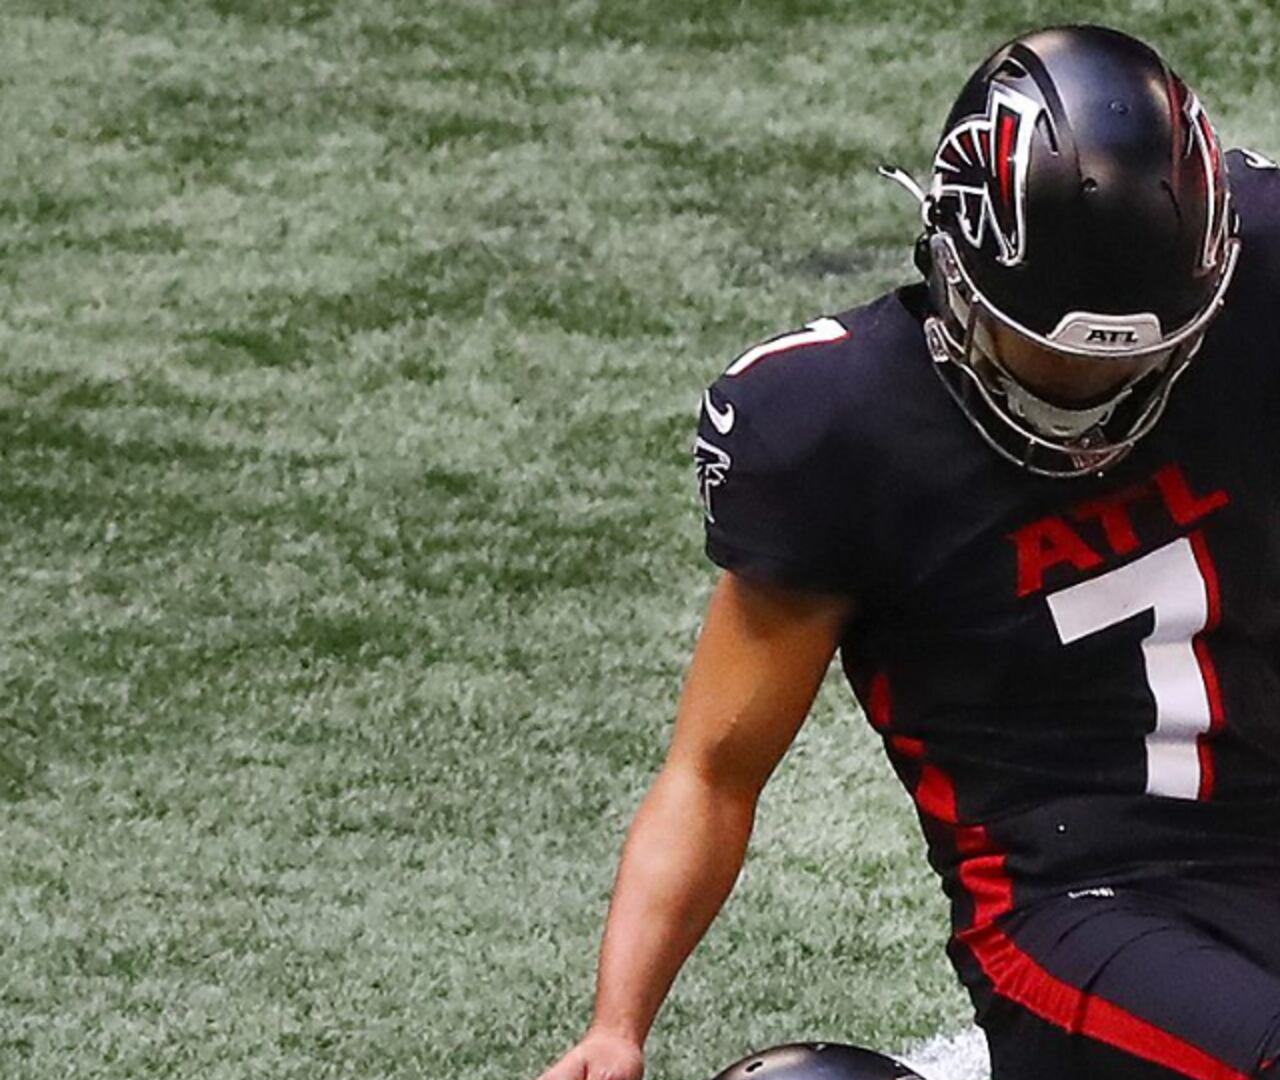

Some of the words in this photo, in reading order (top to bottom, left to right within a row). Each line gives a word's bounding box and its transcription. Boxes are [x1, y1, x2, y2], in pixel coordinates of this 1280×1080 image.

[1086, 329, 1138, 342] ATL
[1007, 464, 1230, 596] ATL
[1046, 533, 1226, 801] 7
